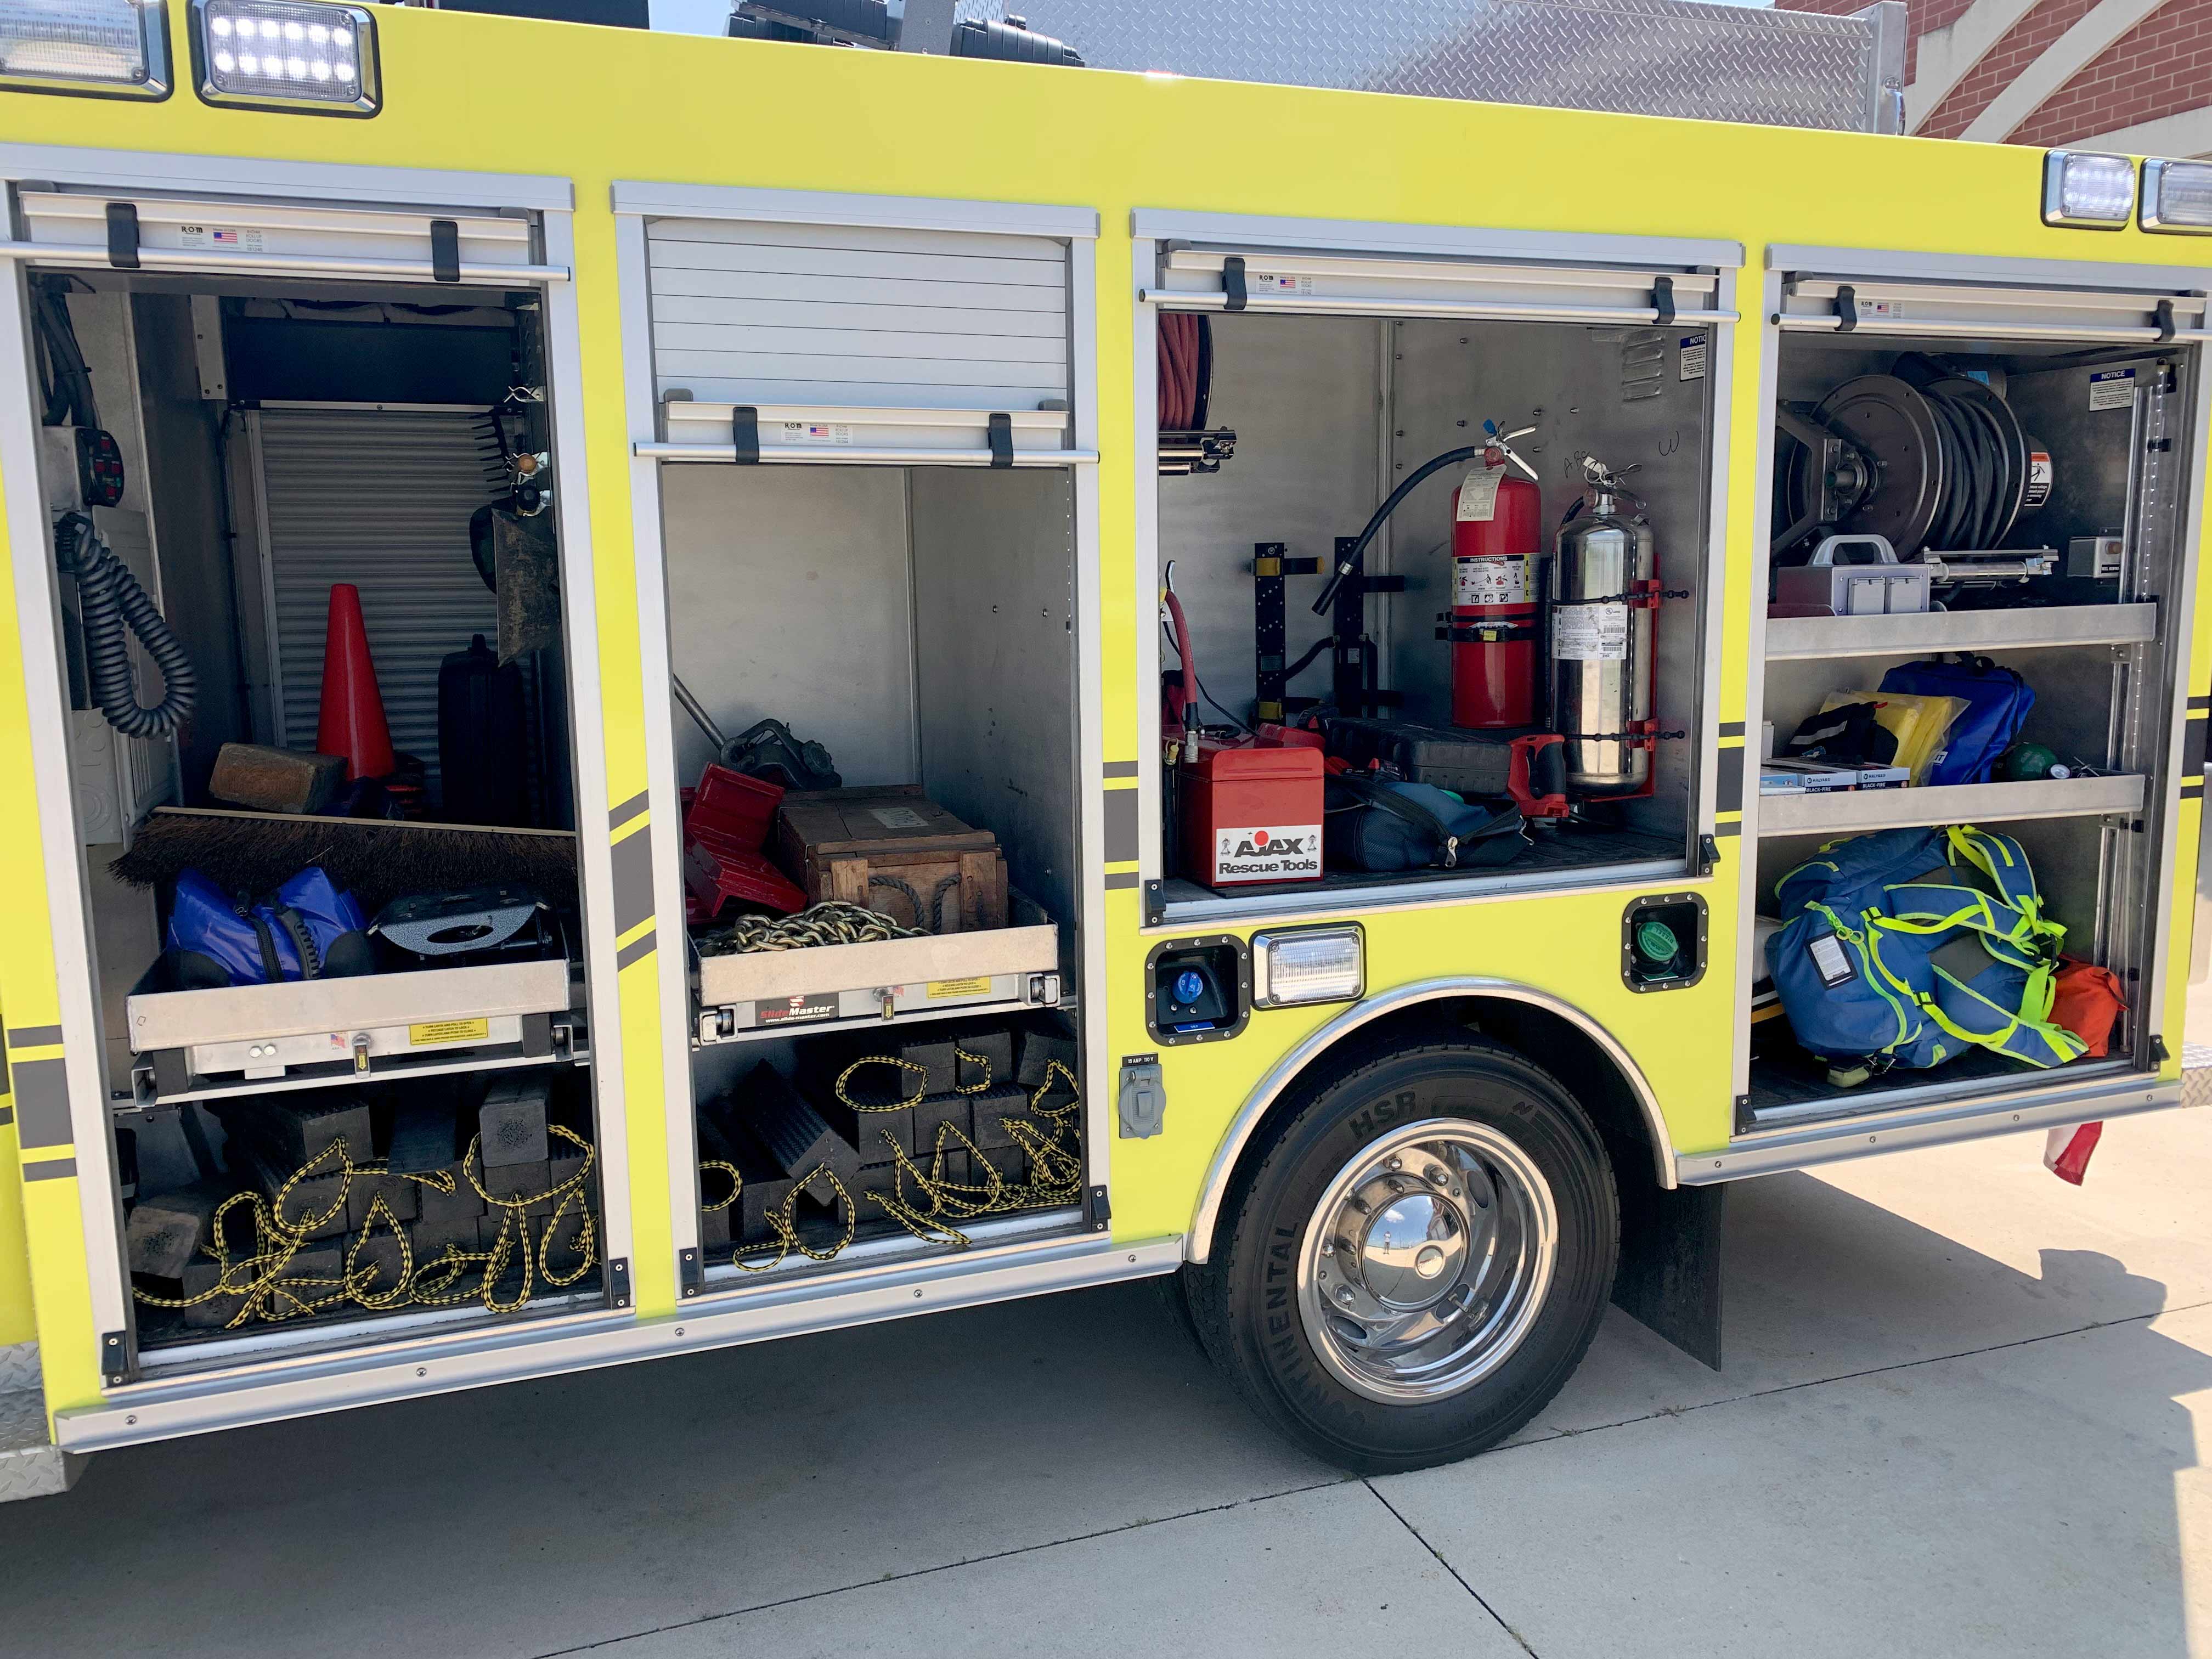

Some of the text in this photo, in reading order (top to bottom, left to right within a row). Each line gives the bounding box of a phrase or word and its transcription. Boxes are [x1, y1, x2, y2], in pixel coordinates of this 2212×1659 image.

[1690, 335, 1706, 345] NOTIC
[2101, 370, 2125, 380] NOTICE
[1219, 859, 1317, 874] Rescue Tools
[760, 1006, 833, 1019] SlideMaster
[765, 1013, 830, 1023] www.slide-master.com
